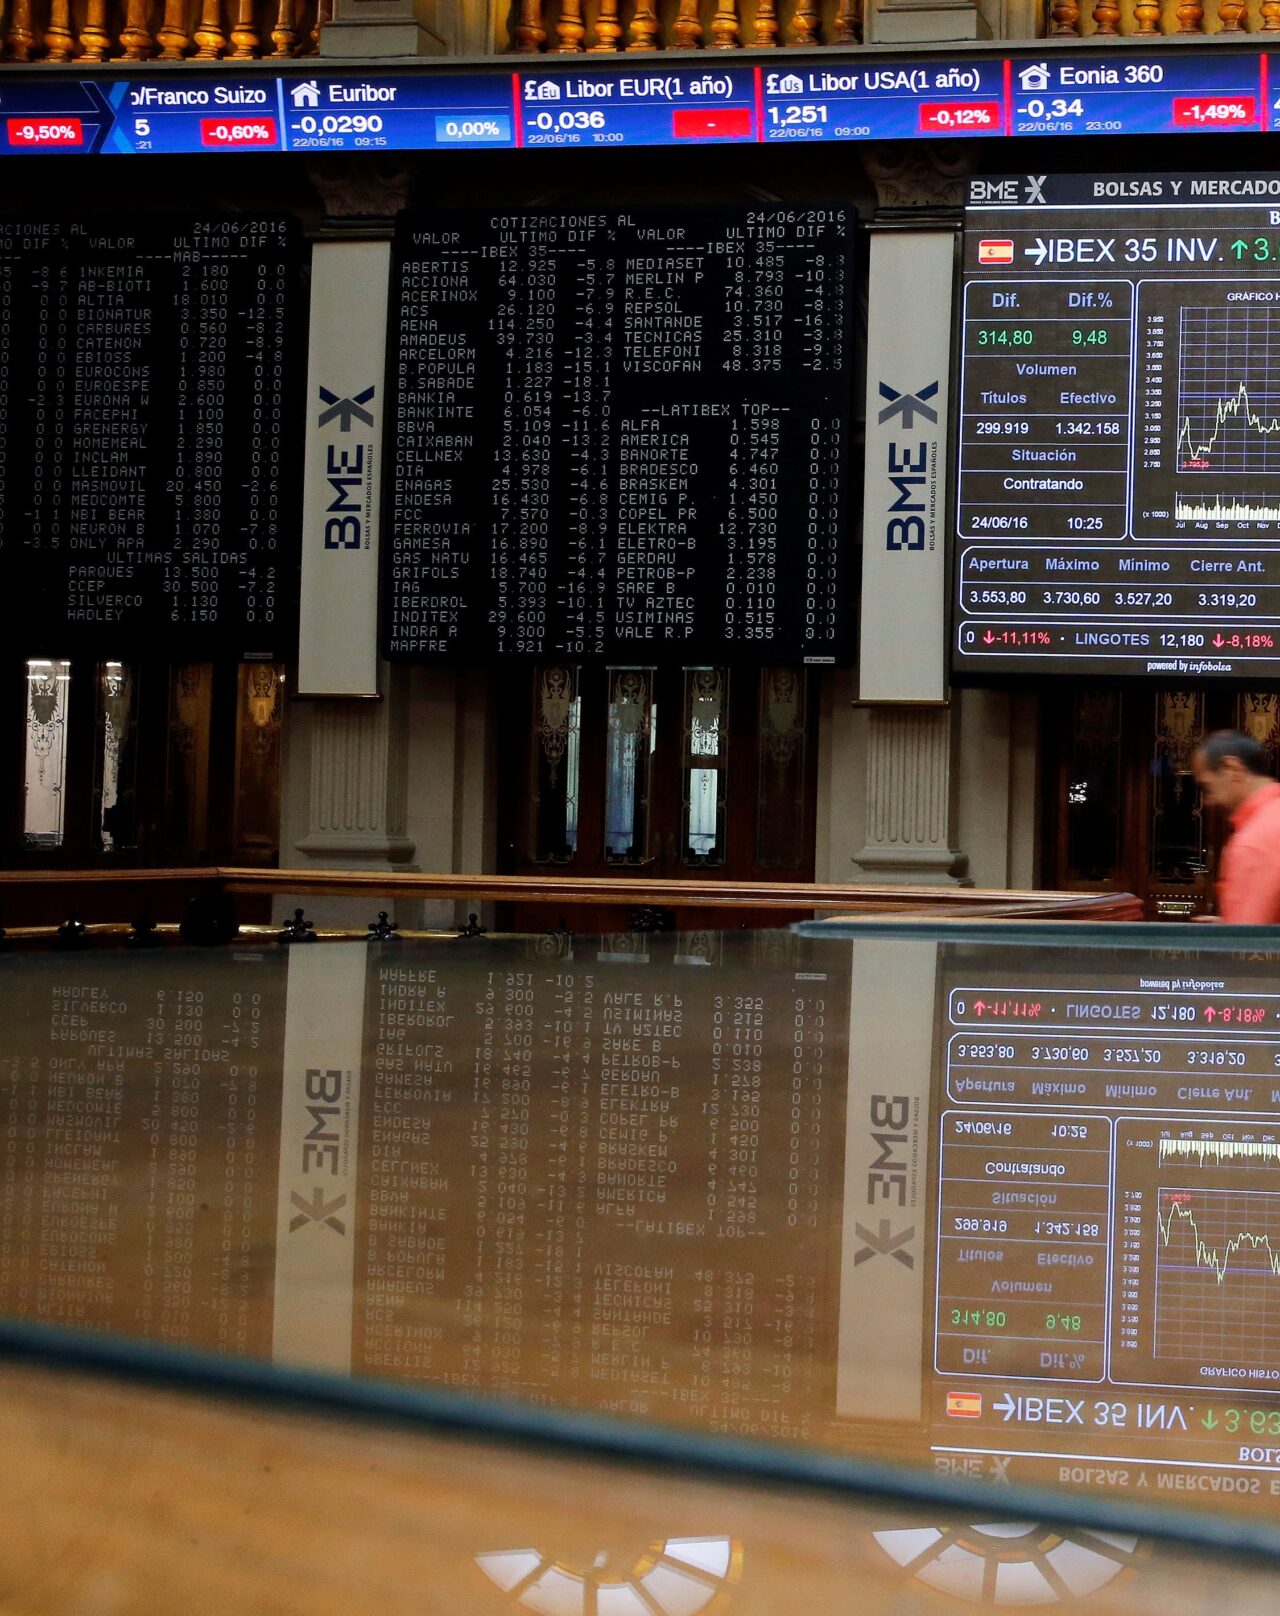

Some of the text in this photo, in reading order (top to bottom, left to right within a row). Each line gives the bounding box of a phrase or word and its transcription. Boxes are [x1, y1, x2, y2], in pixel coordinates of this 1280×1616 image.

[810, 73, 858, 91] Libor
[865, 70, 929, 92] USA(1
[936, 68, 980, 91] año)
[1061, 65, 1163, 84] Eonia 360
[215, 86, 266, 103] Suizo
[329, 84, 396, 102] Euribor
[566, 80, 614, 97] Libor
[620, 77, 684, 99] EUR(1
[690, 76, 732, 98] año)
[767, 105, 990, 126] 1,251 -0,12%
[1017, 99, 1246, 121] -0,34 -1,49%
[290, 115, 499, 138] -0,0290 0,00%
[526, 111, 606, 133] -0,036
[16, 126, 75, 141] -9,50%
[209, 125, 268, 141] -0,60%
[293, 134, 343, 146] 22/06/16
[528, 131, 580, 143] 22/06/16
[970, 181, 1019, 200] BME
[1094, 181, 1162, 196] BOLSAS
[1171, 181, 1182, 195] Y
[1049, 238, 1116, 264] IBEX
[1125, 239, 1157, 261] 35
[1168, 238, 1223, 261] INV.
[403, 260, 555, 273] ABERTIS 12.925
[625, 302, 682, 313] REPSOL
[993, 293, 1112, 307] Dif. Dif.%
[400, 334, 466, 345] AMADEUS
[979, 330, 1107, 346] 314,80 9,48
[624, 361, 700, 372] VISCOFAN
[1016, 364, 1076, 375] Volumen
[981, 391, 1116, 403] Títulos Efectivo
[977, 423, 1119, 434] 299.919 1.342.158
[1012, 449, 1076, 461] Situación
[1004, 478, 1083, 489] Contratando
[324, 444, 363, 550] BME
[887, 442, 927, 550] BME
[972, 517, 1102, 529] 24/06/16 10:25
[1176, 521, 1186, 530] Jul
[1195, 521, 1209, 532] Aug
[1215, 522, 1229, 532] Sep
[1237, 522, 1250, 530] Oct
[1257, 522, 1270, 530] Nov
[969, 558, 1028, 571] Apertura
[1046, 557, 1099, 570] Máximo
[1119, 558, 1169, 570] Mínimo
[1191, 560, 1232, 571] Cierre
[1236, 559, 1267, 573] Ant.
[970, 591, 1026, 605] 3.553,80
[1044, 592, 1100, 606] 3.730,60
[1115, 593, 1172, 606] 3.527,20
[1199, 594, 1255, 608] 3.319,20
[391, 640, 447, 651] MAPFRE
[994, 632, 1050, 645] -11,11%
[1076, 633, 1149, 645] LINGOTES
[1160, 634, 1204, 648] 12,180
[1223, 635, 1273, 648] -8,18%
[1147, 660, 1232, 674] powered by infobolsa
